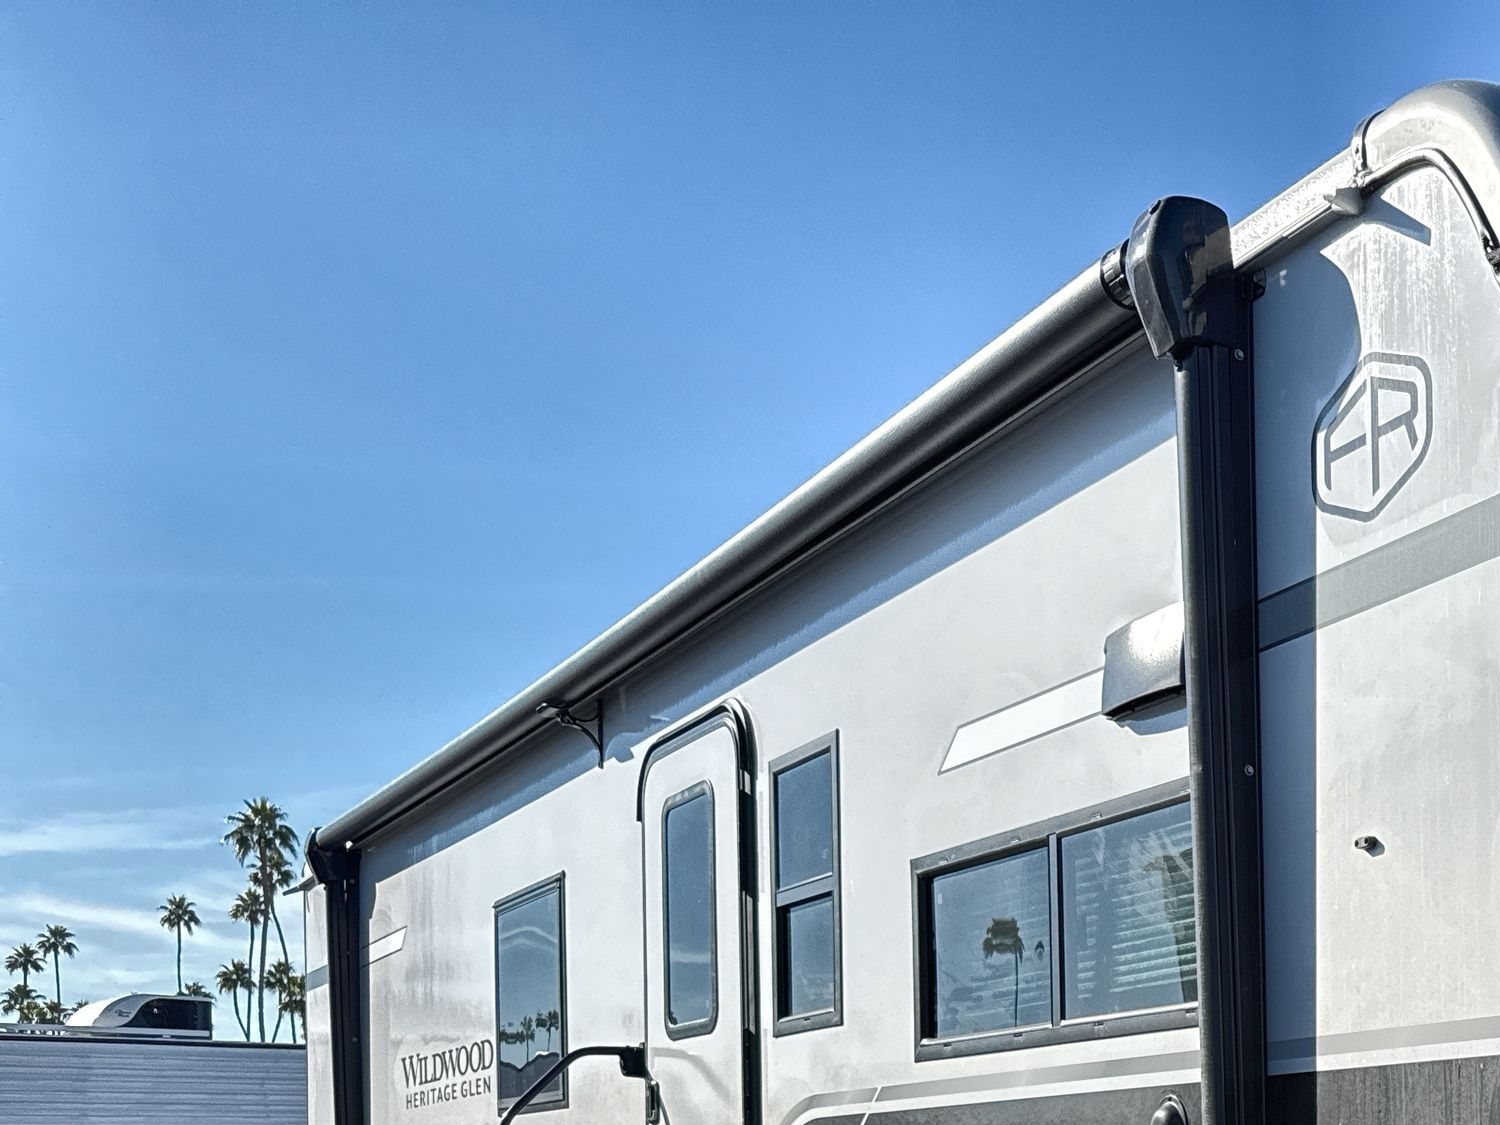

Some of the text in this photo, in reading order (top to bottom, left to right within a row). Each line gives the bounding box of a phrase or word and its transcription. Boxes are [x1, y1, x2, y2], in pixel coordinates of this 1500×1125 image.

[401, 1039, 494, 1088] WILDWOOD
[406, 1076, 491, 1110] HERITAGE GLEN
